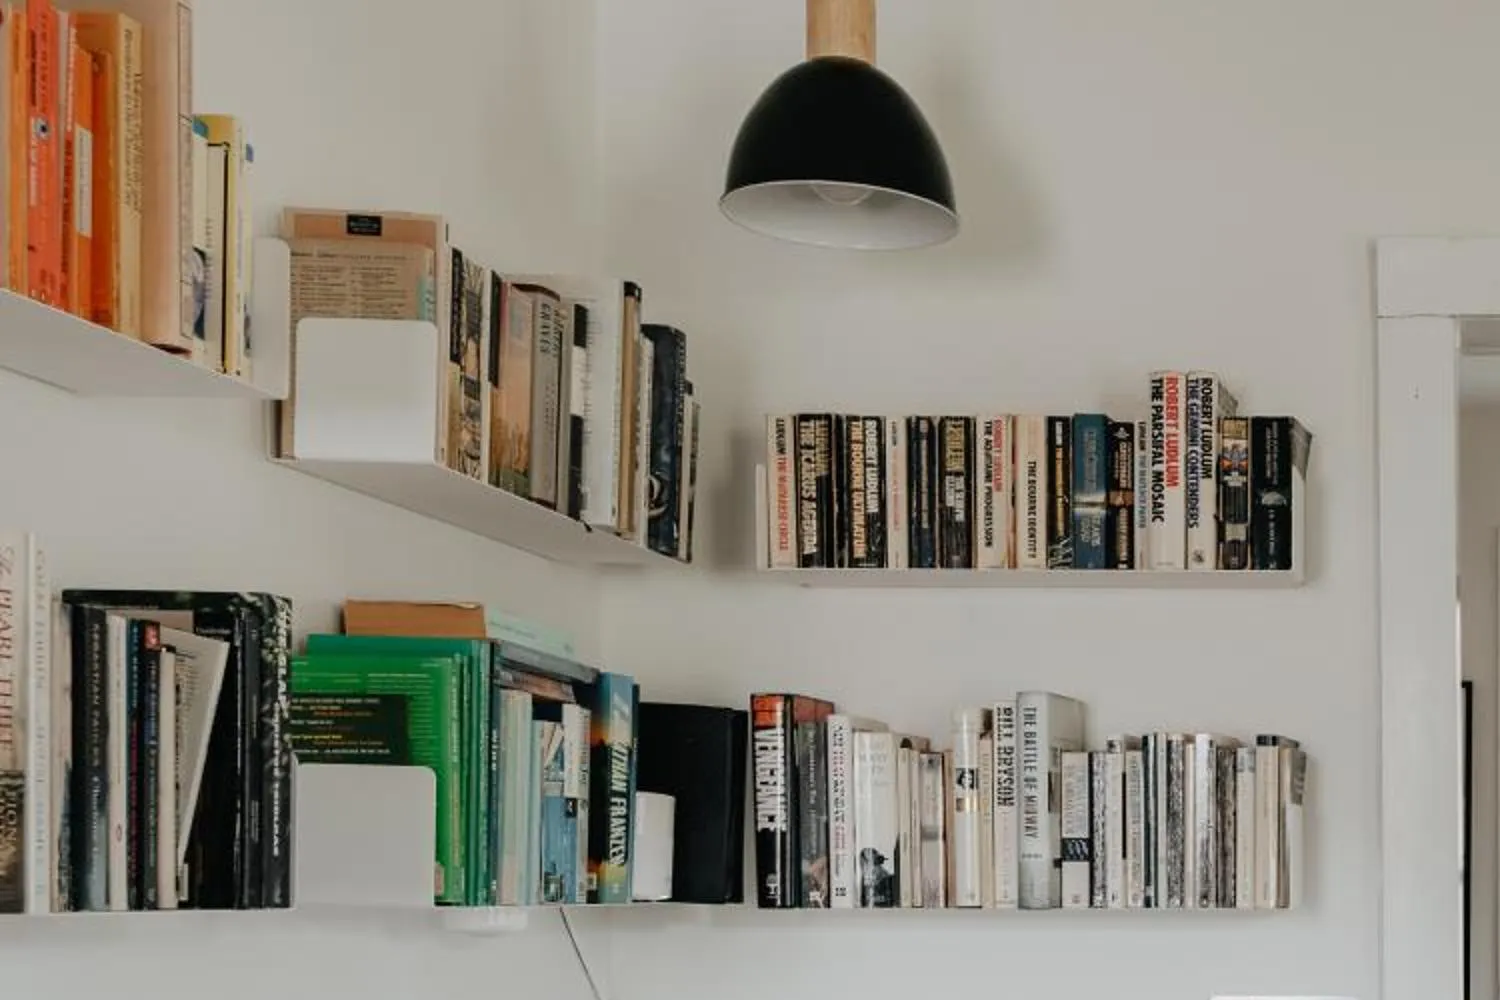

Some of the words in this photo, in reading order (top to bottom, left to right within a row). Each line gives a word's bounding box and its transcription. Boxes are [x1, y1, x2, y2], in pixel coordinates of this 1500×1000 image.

[1151, 378, 1164, 402] THE
[1166, 376, 1179, 429] ROBERT
[1188, 378, 1199, 401] THE
[1200, 377, 1213, 426] ROBERT
[799, 420, 815, 446] THE
[850, 420, 864, 441] THE
[866, 420, 878, 465] ROBERT
[983, 421, 993, 436] THE
[1151, 405, 1164, 467] PARSIFAL
[1188, 403, 1200, 446] GEMINI
[800, 449, 817, 499] ICARUS
[851, 443, 866, 490] BOURNE
[1027, 461, 1037, 477] THE
[1166, 432, 1180, 488] LUDLUM
[1200, 428, 1213, 479] LUDLUM
[866, 467, 879, 513] LUDLUM
[1027, 479, 1037, 516] BOURNE
[1151, 470, 1164, 523] MOSAIC
[1188, 449, 1200, 529] CONTENDERS
[801, 500, 817, 555] AGENDA
[983, 485, 994, 548] PROGRESSION
[1027, 518, 1037, 559] IDENTITY
[997, 707, 1015, 741] BILL
[1023, 707, 1038, 727] THE
[1023, 731, 1038, 772] BATTLE
[755, 727, 787, 832] VENGEANCE
[997, 745, 1016, 807] BRYSON
[1023, 776, 1038, 791] OF
[608, 797, 629, 865] FRANZEN
[1023, 795, 1039, 839] MIDWAY
